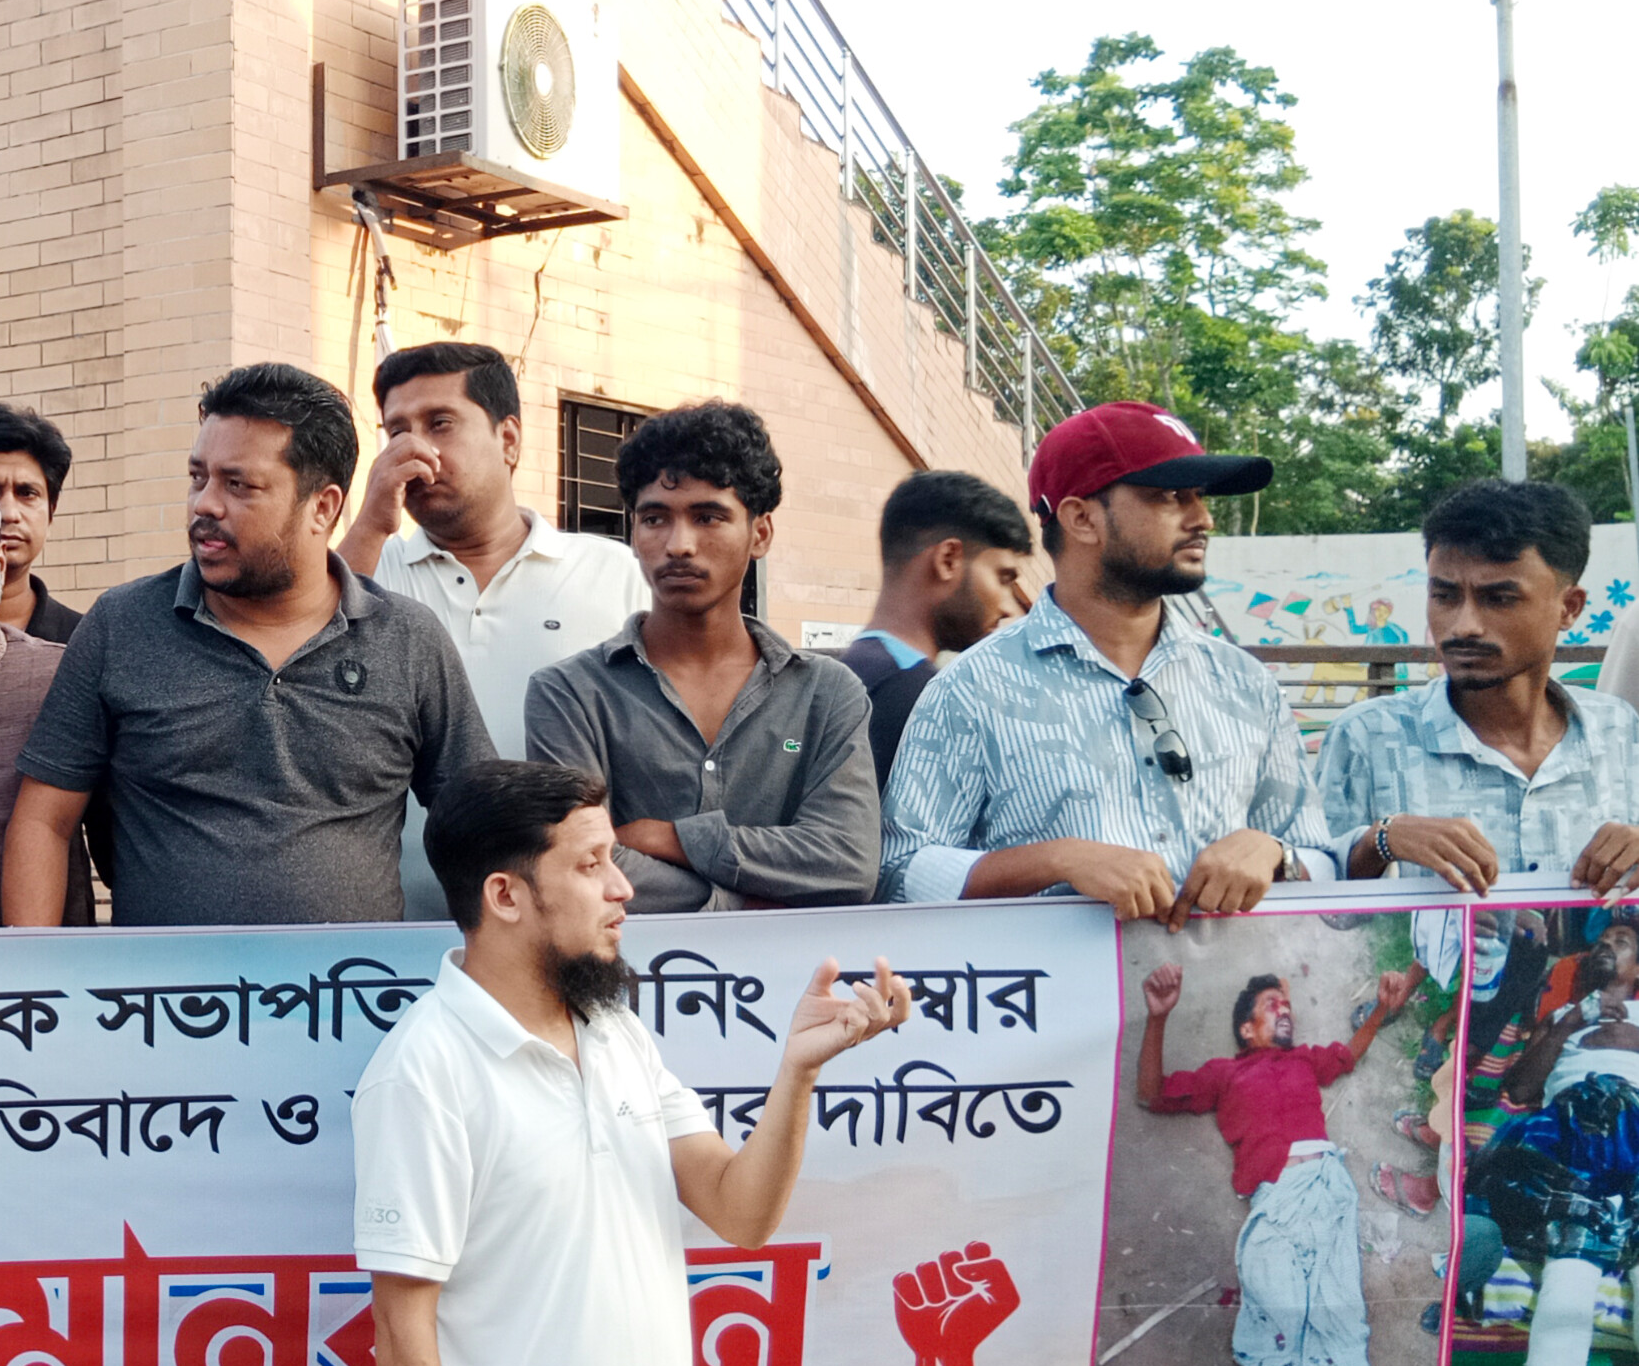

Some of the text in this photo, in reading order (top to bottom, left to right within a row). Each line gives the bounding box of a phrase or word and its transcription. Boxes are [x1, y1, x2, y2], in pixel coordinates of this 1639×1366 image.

[85, 956, 436, 1048] সভাপতি
[625, 949, 777, 1043] ানিং
[261, 1094, 320, 1146] ও
[811, 1060, 1075, 1147] দাবিতে
